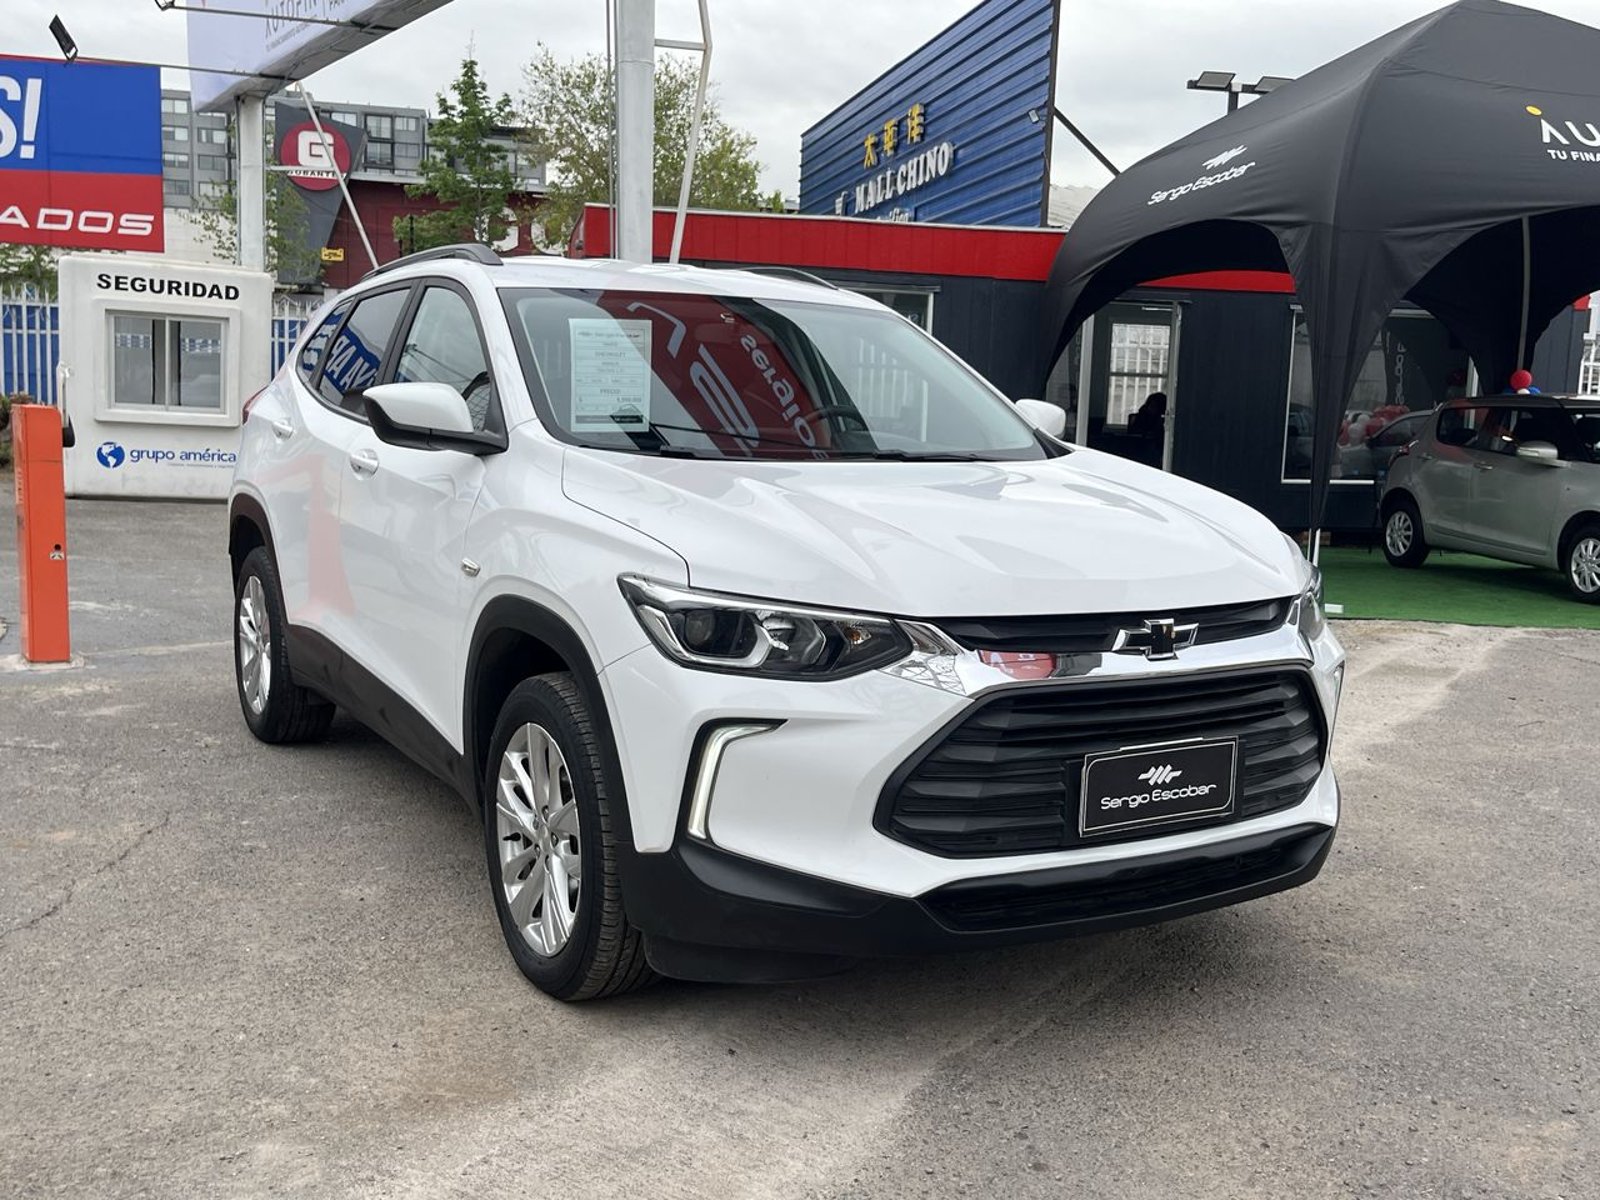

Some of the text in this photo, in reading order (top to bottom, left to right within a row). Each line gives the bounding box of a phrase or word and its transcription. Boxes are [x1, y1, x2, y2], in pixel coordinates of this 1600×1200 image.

[1547, 149, 1568, 160] TU
[855, 170, 895, 214] MALL
[897, 142, 954, 196] CHINO
[1192, 161, 1256, 191] Escobar
[0, 205, 155, 236] ADOS
[96, 273, 240, 301] SEGURIDAD
[129, 447, 237, 463] grupo américa
[1151, 783, 1217, 802] Escobar
